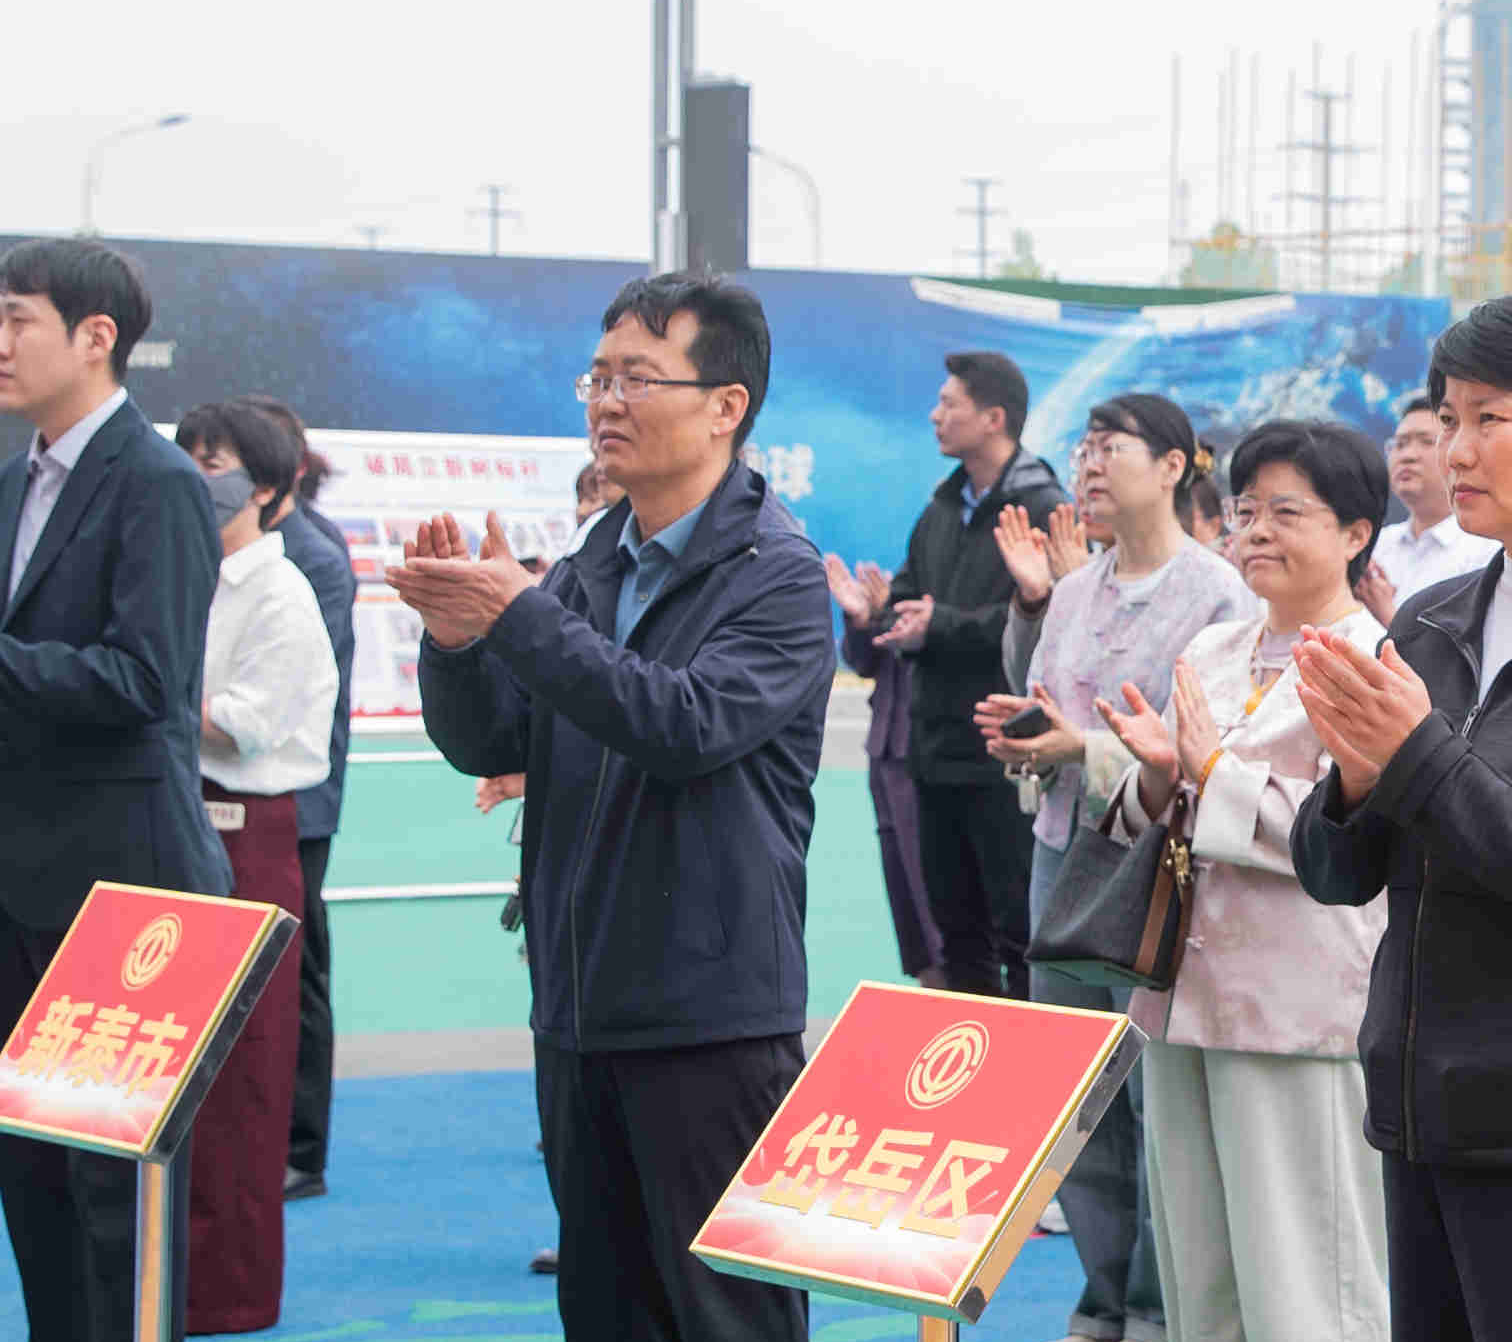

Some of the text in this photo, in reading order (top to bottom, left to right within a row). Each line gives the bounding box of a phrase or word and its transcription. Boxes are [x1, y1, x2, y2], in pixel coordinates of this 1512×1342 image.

[16, 995, 189, 1099] 新泰市
[760, 1112, 1010, 1240] 岱岳区
